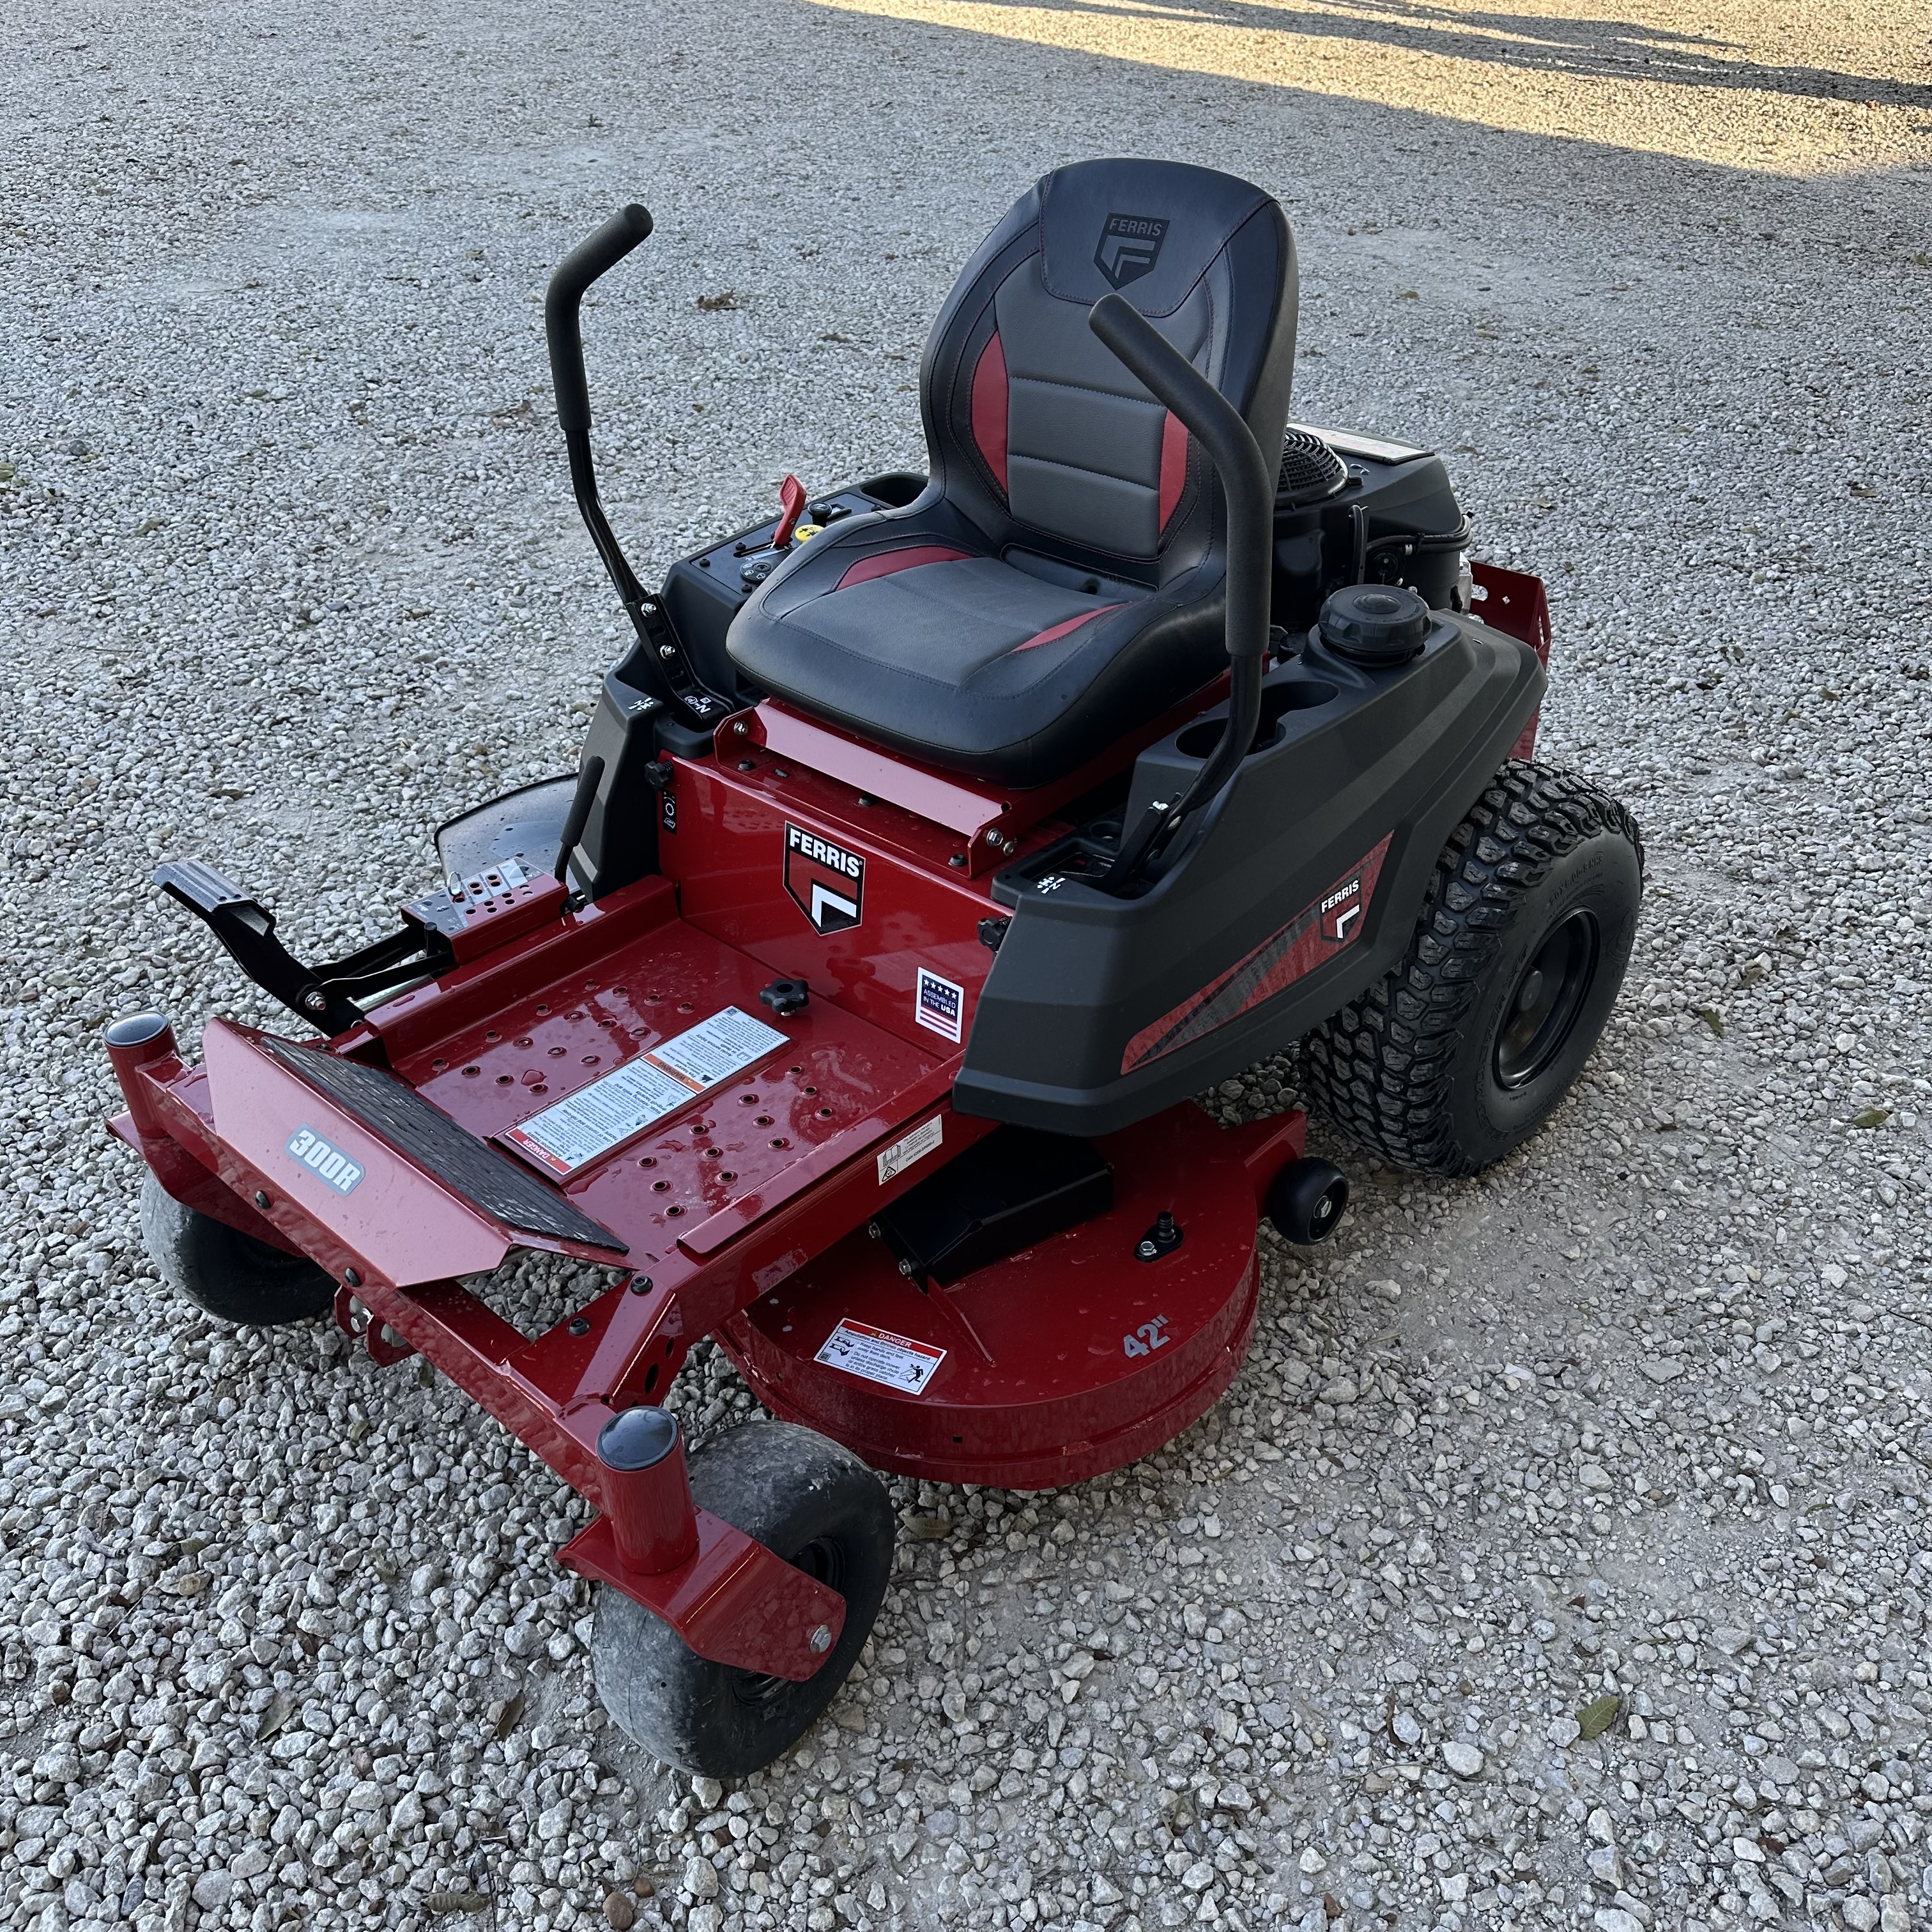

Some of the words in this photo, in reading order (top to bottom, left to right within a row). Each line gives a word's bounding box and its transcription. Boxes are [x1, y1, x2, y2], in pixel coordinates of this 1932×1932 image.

[1109, 217, 1163, 236] FERRIS
[790, 827, 859, 877] FERRIS
[1321, 879, 1360, 914] FERRIS
[923, 988, 956, 1009] ASSEMBLED
[930, 999, 940, 1009] THE
[940, 1004, 956, 1016] USA
[657, 1062, 686, 1080] WARNING
[523, 1138, 549, 1158] DANGER
[289, 1130, 360, 1191] 300R
[878, 1333, 911, 1347] DANGER
[1123, 1314, 1171, 1359] 42"
